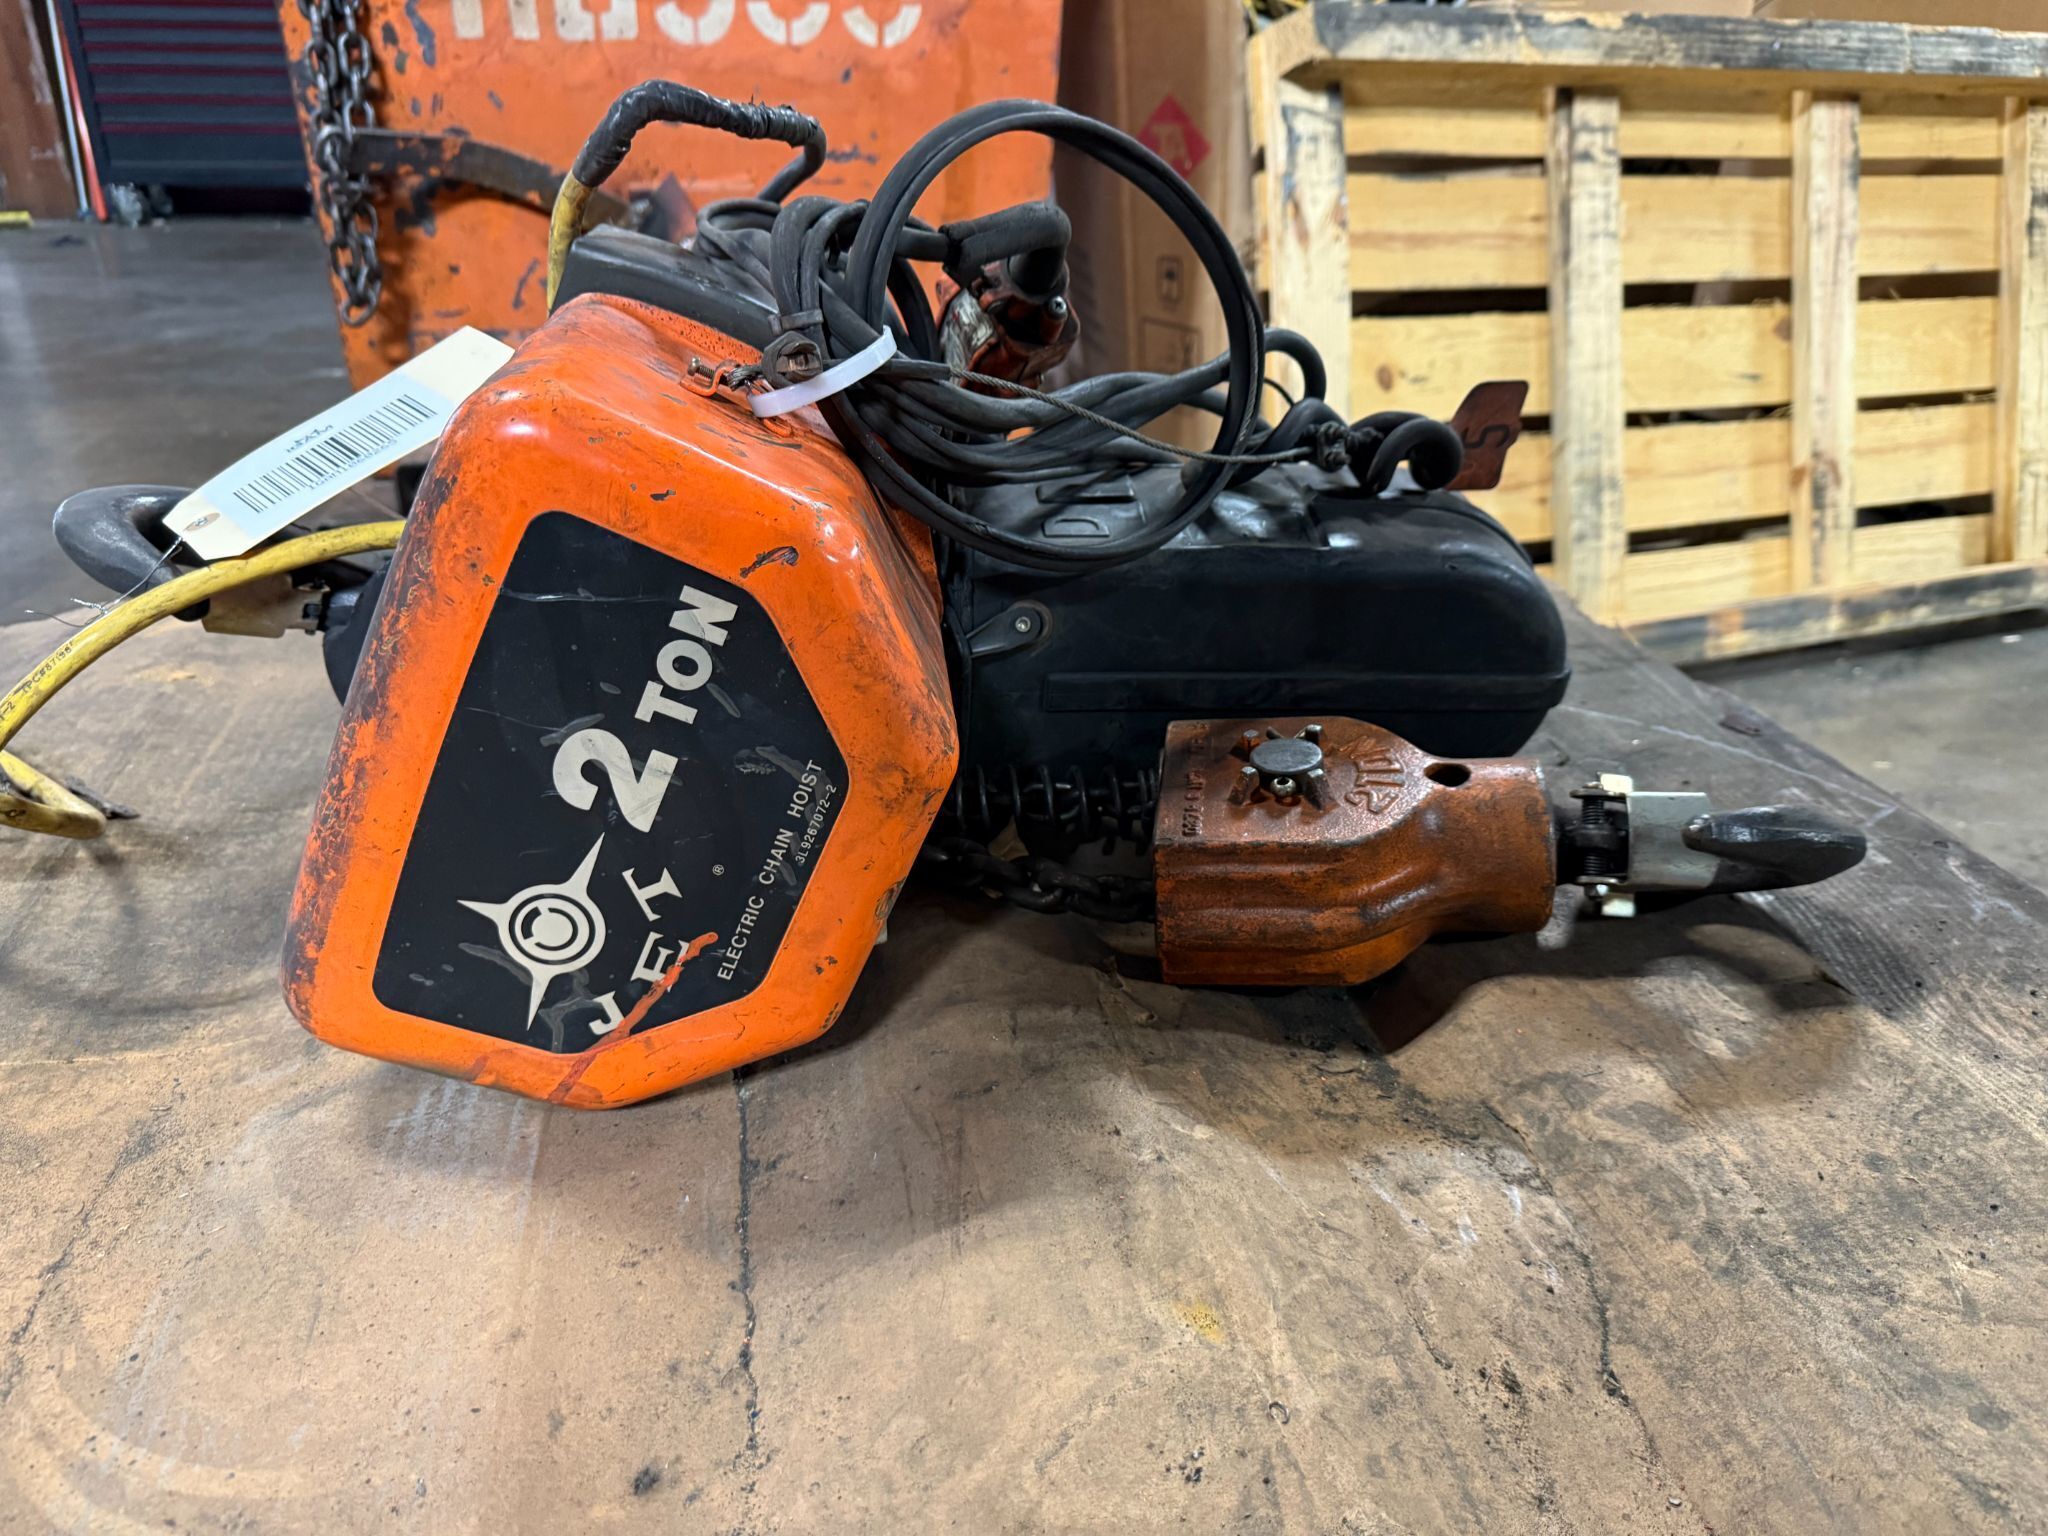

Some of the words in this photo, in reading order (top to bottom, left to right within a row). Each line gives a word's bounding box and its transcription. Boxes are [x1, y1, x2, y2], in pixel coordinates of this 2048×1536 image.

[552, 728, 678, 833] 2
[634, 584, 739, 725] TON
[716, 895, 765, 982] ELECTRIC
[758, 827, 794, 886] CHAIN
[787, 758, 824, 819] HOIST
[794, 783, 838, 864] 3L9267072-2
[587, 866, 689, 1036] JET
